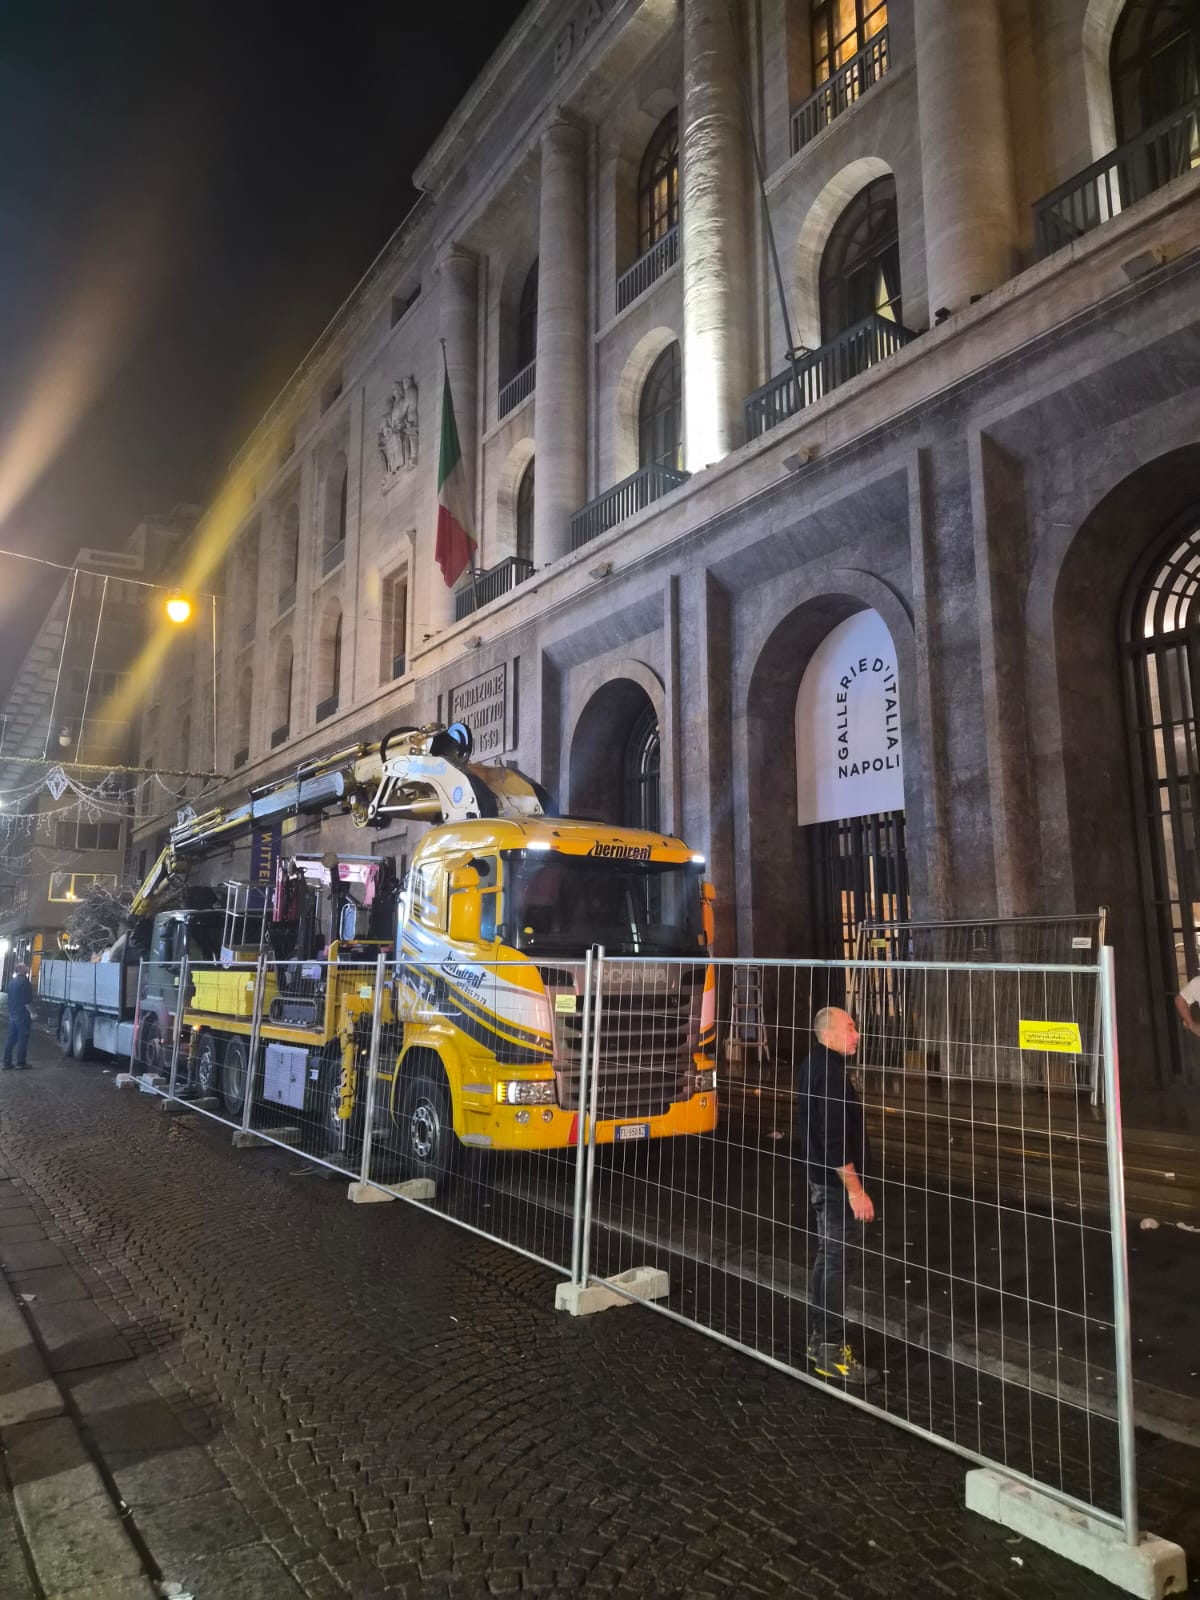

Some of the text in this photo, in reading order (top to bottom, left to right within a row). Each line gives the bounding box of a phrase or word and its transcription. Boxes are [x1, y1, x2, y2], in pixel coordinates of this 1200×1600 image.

[454, 674, 504, 714] FONDAZIONE
[837, 657, 899, 761] GALLERIE D'ITALIA
[838, 754, 900, 779] NAPOLI
